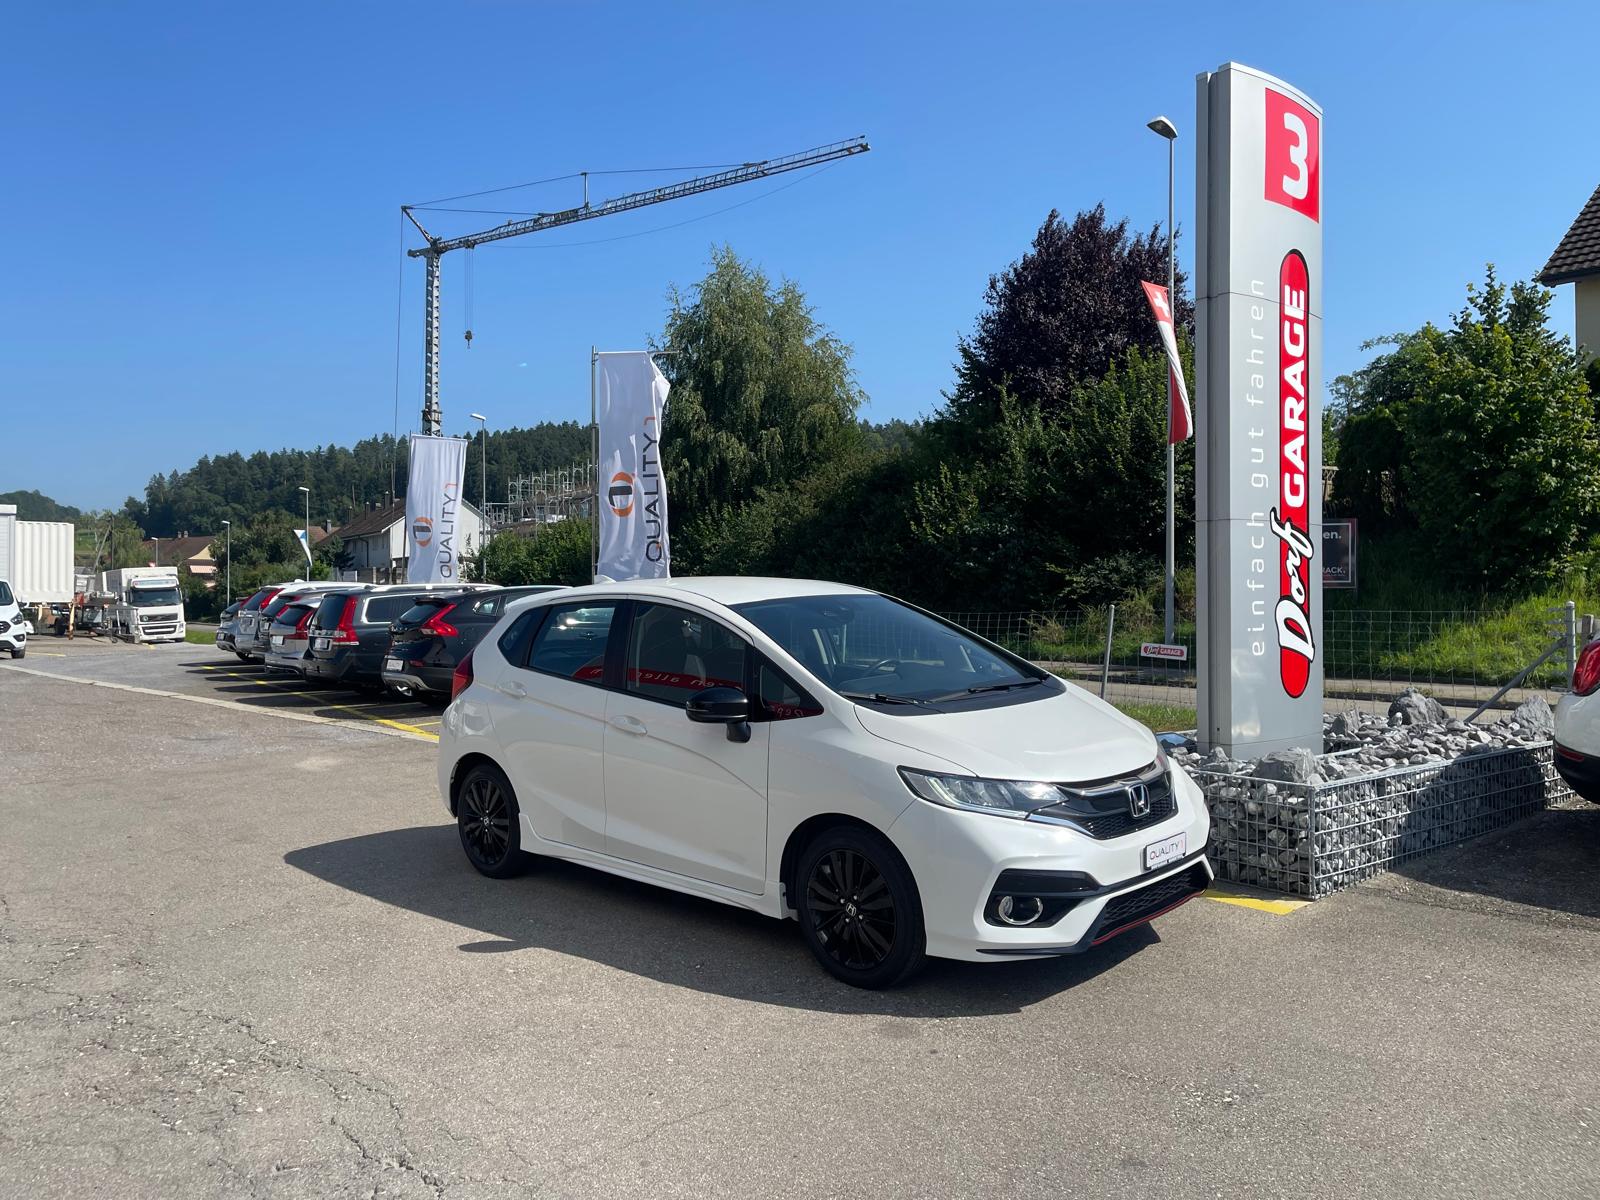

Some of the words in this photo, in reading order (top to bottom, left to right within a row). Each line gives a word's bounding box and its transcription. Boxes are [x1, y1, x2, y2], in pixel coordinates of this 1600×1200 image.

[1282, 112, 1309, 200] 3
[1246, 279, 1265, 406] fahren
[1283, 284, 1305, 508] GARAGE
[642, 432, 662, 563] QUALITY
[1248, 428, 1269, 488] gut
[440, 493, 456, 578] QUALITY
[1246, 511, 1265, 657] einfach
[1270, 508, 1315, 662] Dorf
[1149, 841, 1180, 860] QUALITY
